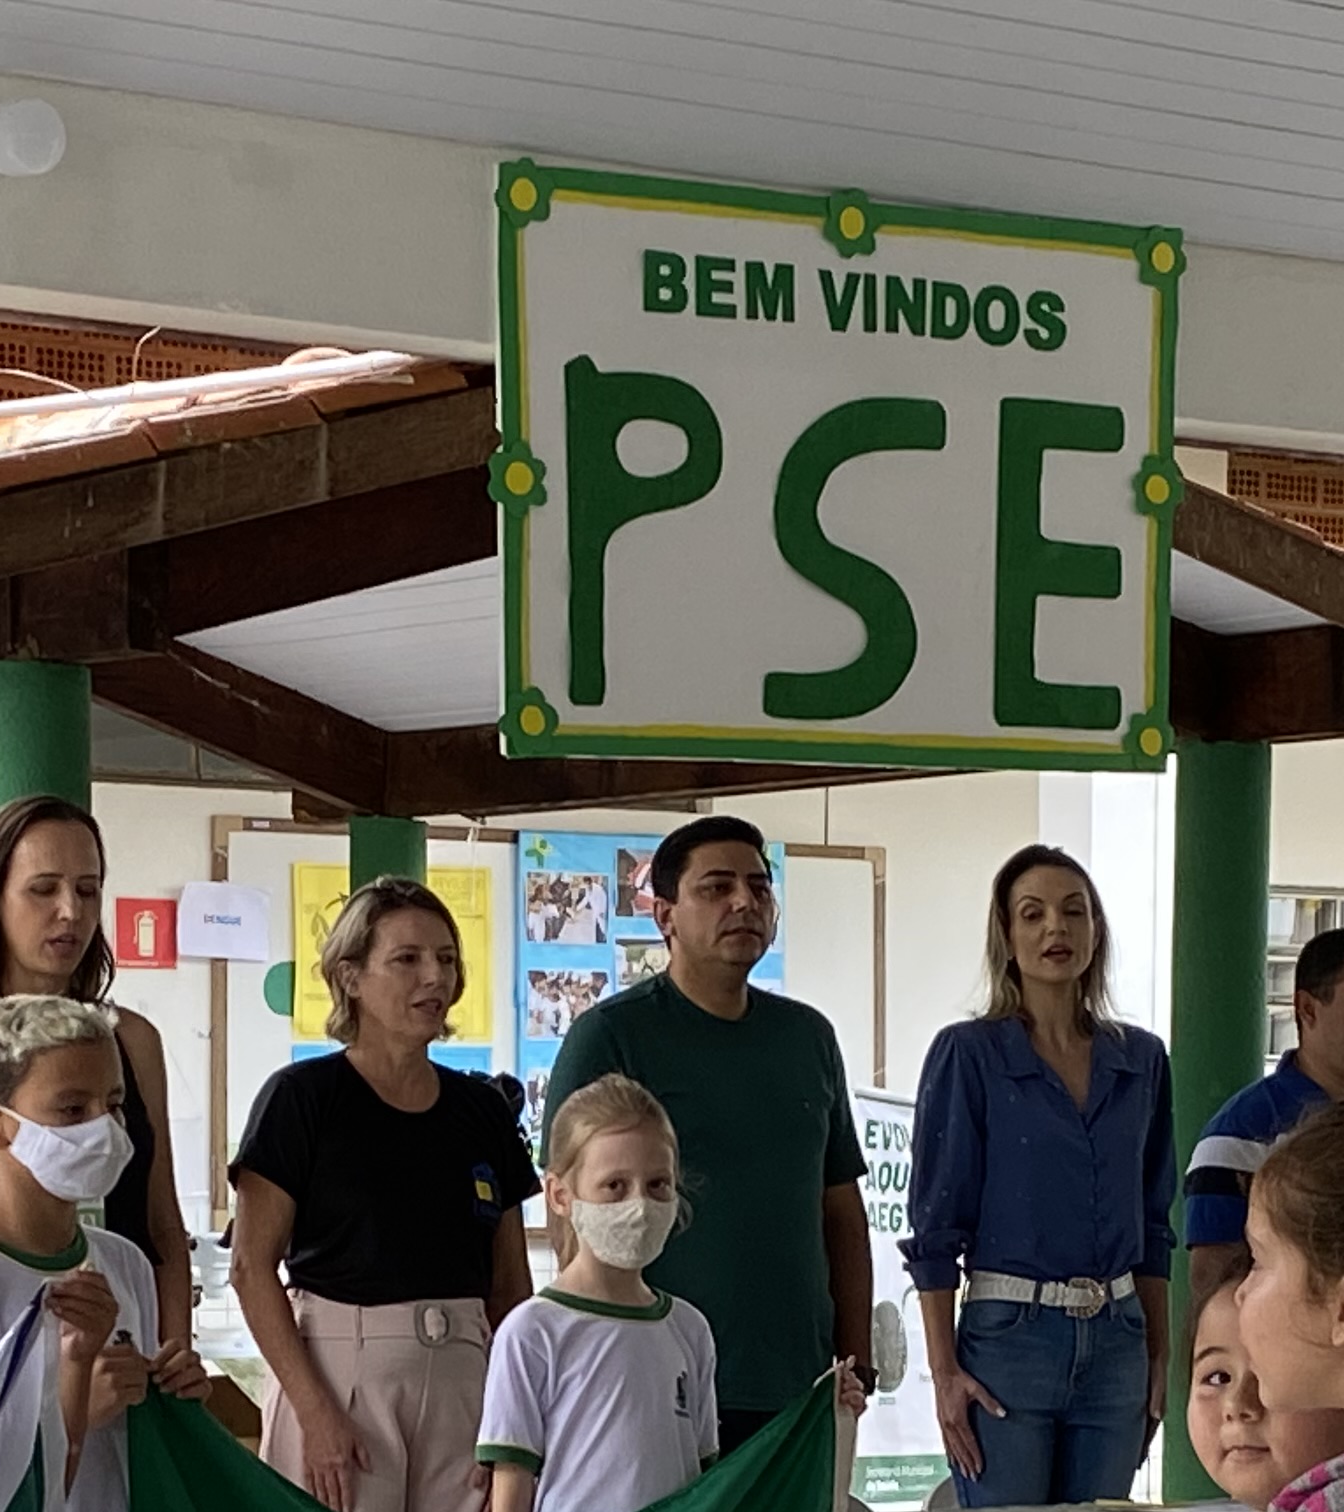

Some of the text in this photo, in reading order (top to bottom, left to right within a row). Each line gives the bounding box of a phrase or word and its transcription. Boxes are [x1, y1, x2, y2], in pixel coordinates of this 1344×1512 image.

[643, 249, 1067, 351] BEM VINDOS
[564, 354, 1125, 730] PSE
[868, 1201, 911, 1233] AEG
